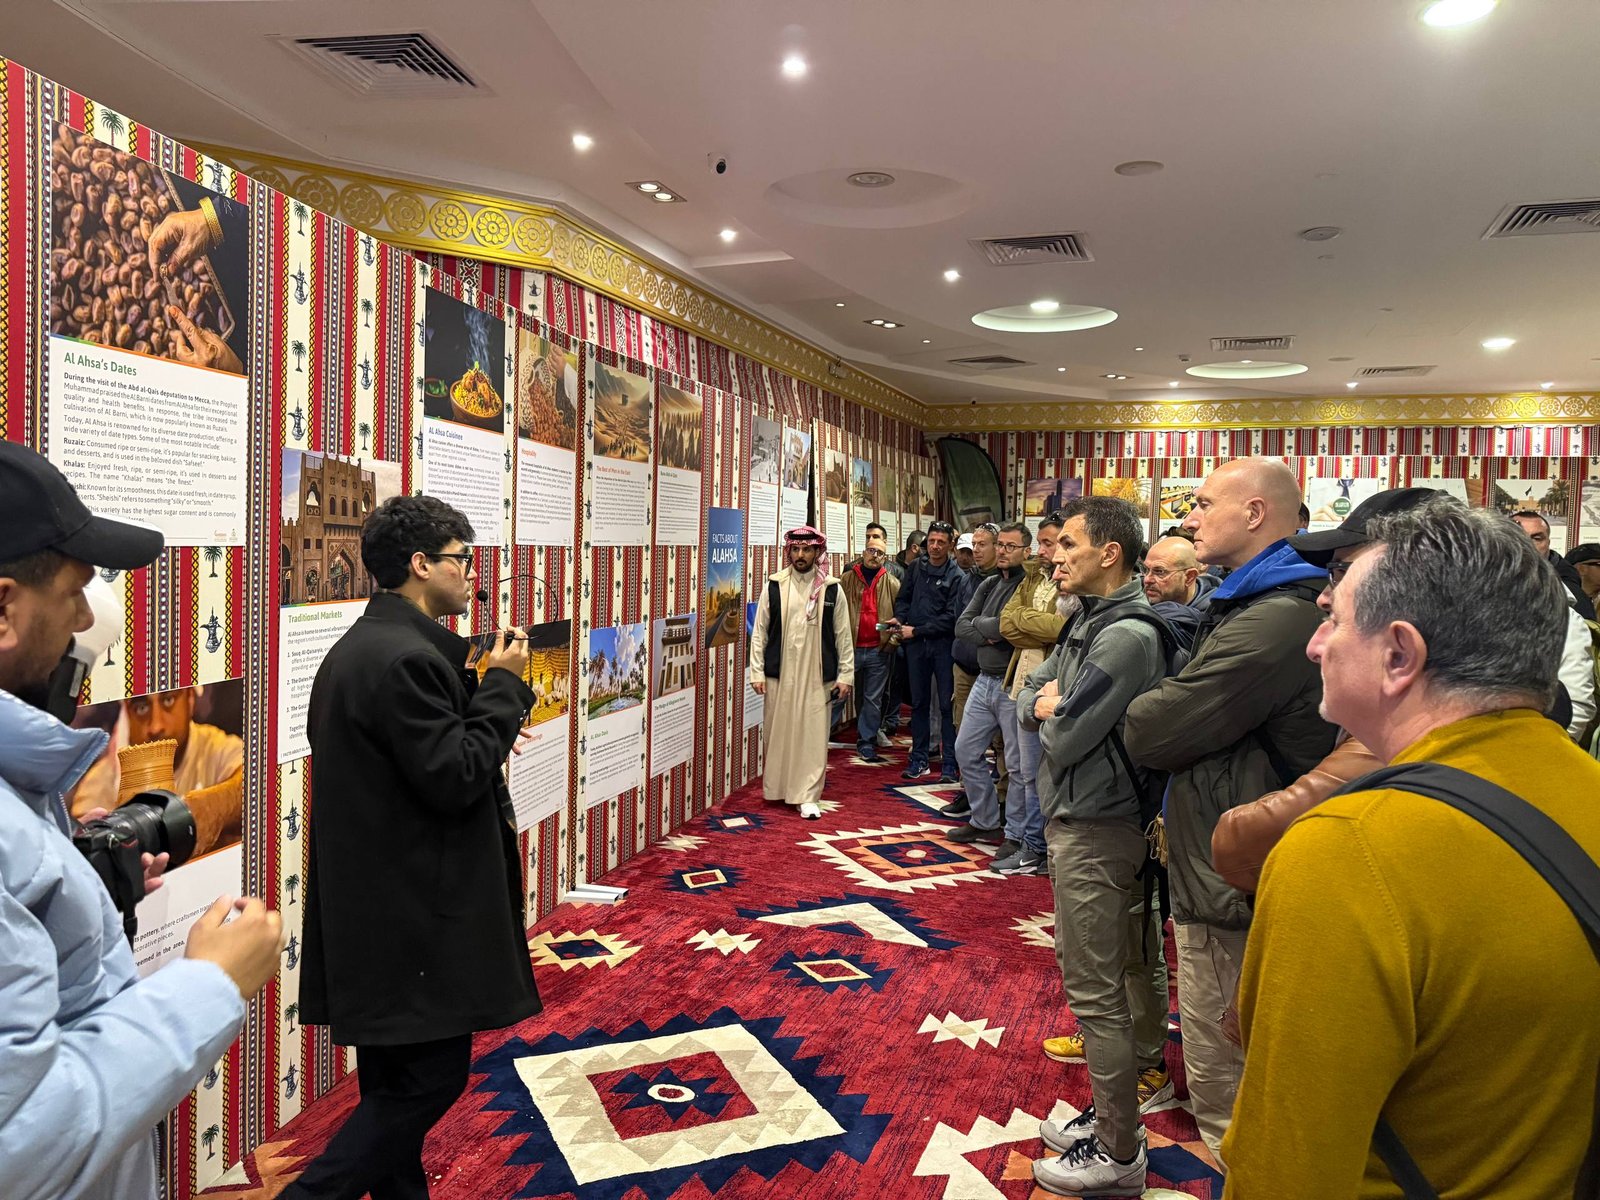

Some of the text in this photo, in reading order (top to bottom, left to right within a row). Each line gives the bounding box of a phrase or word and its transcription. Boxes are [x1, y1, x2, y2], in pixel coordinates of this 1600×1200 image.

[77, 355, 108, 370] Ahsa's
[111, 361, 136, 376] Dates
[64, 372, 84, 383] During
[141, 387, 159, 395] al-Qais
[160, 390, 187, 400] deputation
[713, 534, 738, 543] FACTS ABOUT
[288, 611, 342, 623] Traditional Markets
[140, 927, 160, 942] pottery,
[160, 920, 175, 932] where
[176, 910, 199, 925] craftsmen
[134, 939, 157, 953] ecorative
[136, 955, 154, 966] eemed
[163, 946, 171, 955] the
[173, 940, 185, 949] area.
